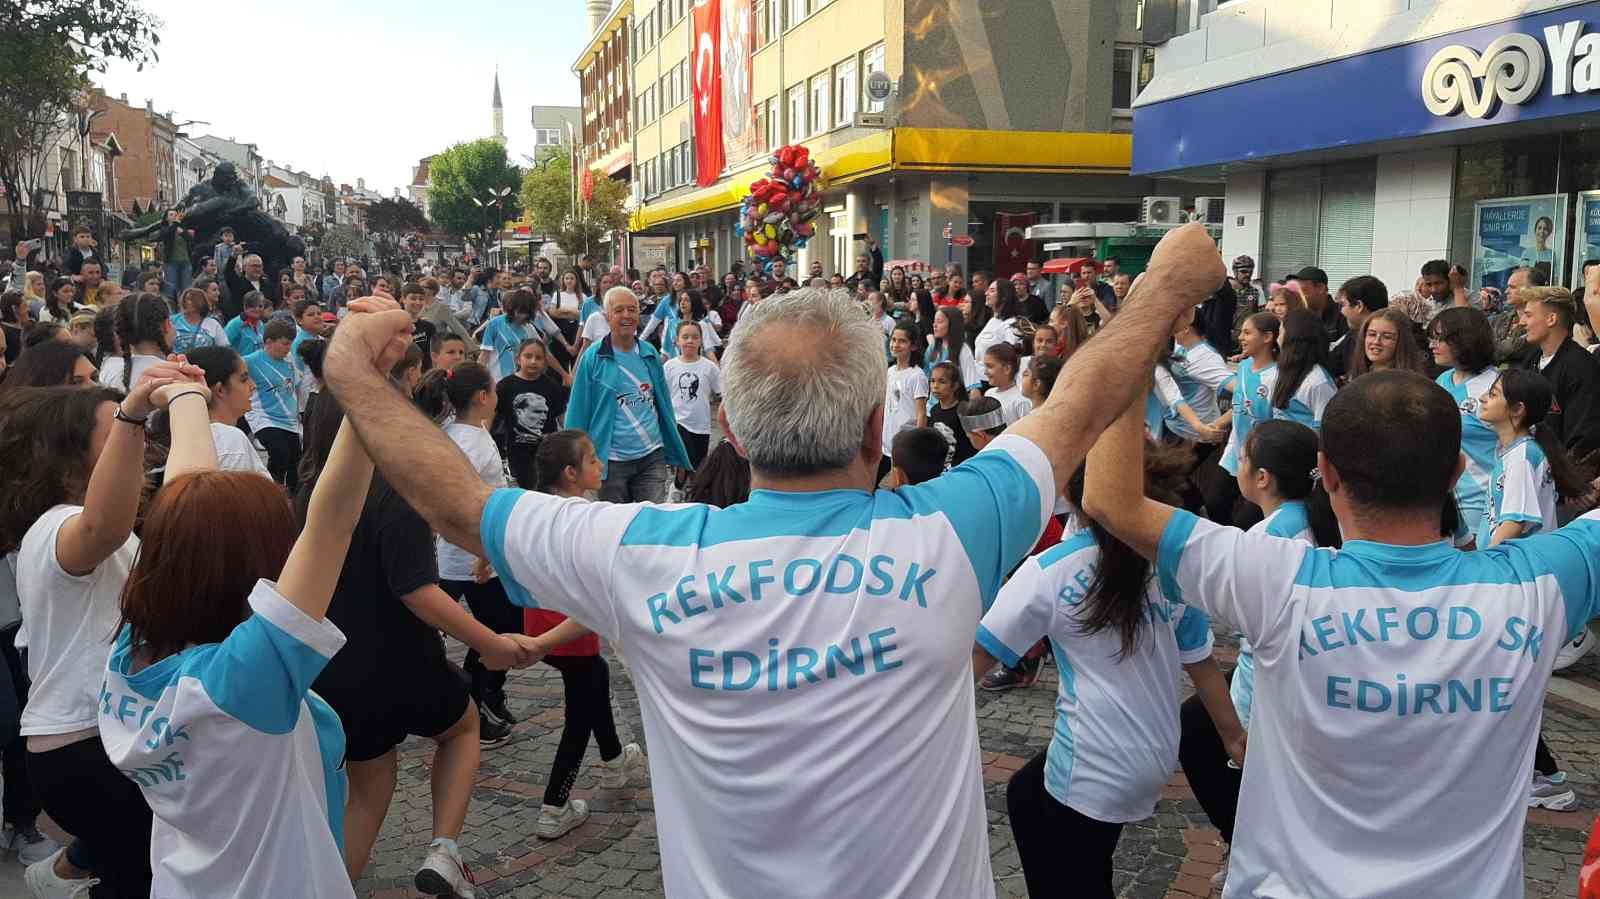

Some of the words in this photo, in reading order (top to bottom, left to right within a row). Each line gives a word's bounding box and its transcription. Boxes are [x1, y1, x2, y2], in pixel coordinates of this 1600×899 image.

[646, 553, 936, 634] REKFODSK
[689, 627, 903, 691] EDİRNE
[1327, 674, 1513, 716] EDİRNE
